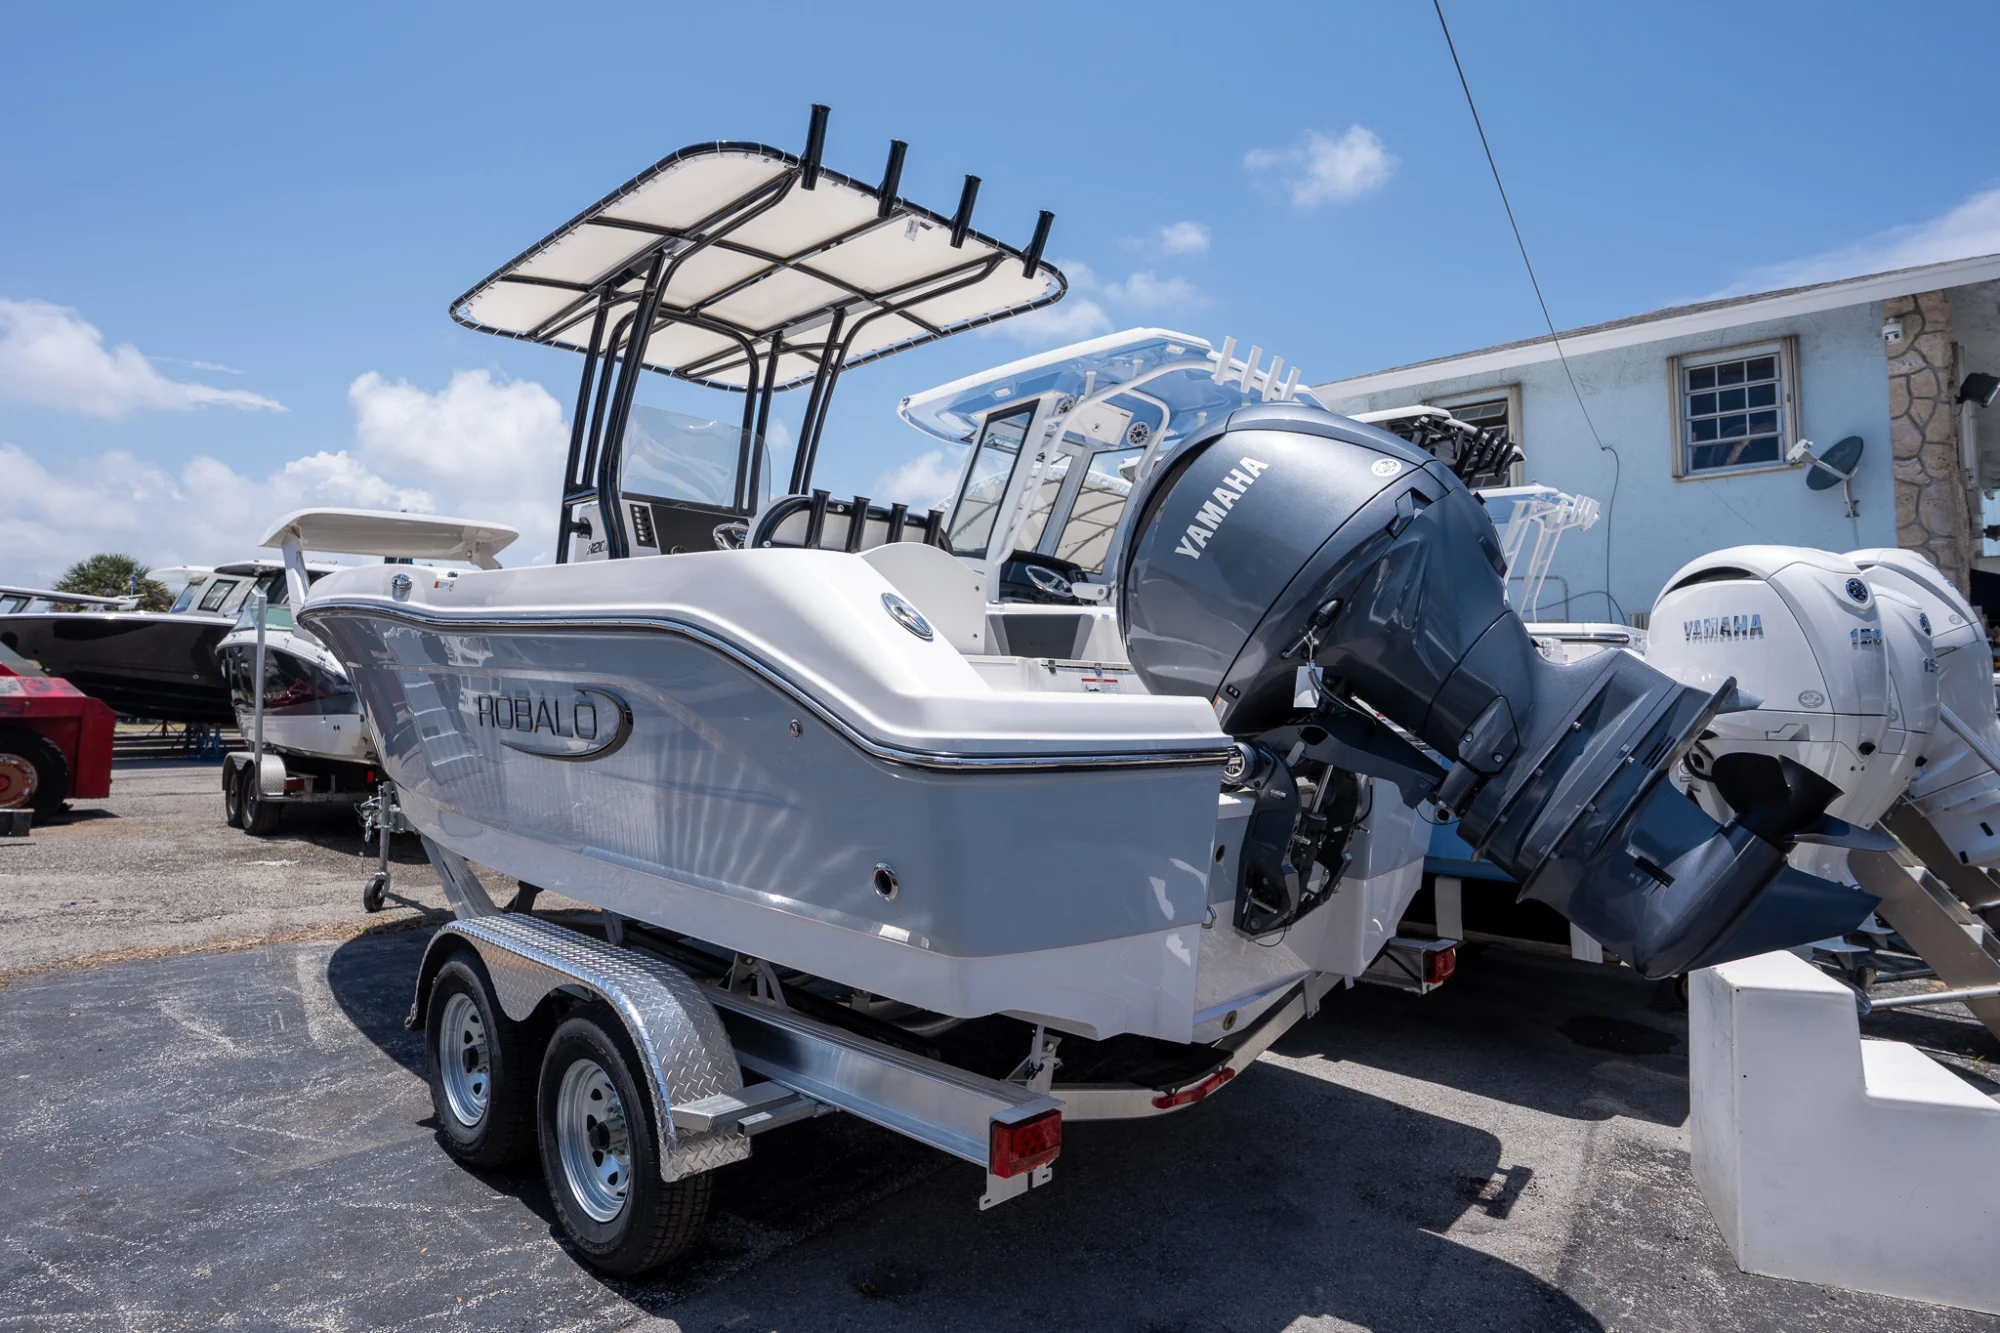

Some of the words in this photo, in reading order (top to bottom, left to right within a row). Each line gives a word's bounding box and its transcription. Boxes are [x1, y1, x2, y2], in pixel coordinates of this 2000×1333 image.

[1174, 456, 1270, 560] YAMAHA
[1683, 613, 1764, 641] YAMAHA
[1849, 628, 1881, 646] 150
[1923, 657, 1938, 673] 15
[478, 694, 597, 740] ROBALO
